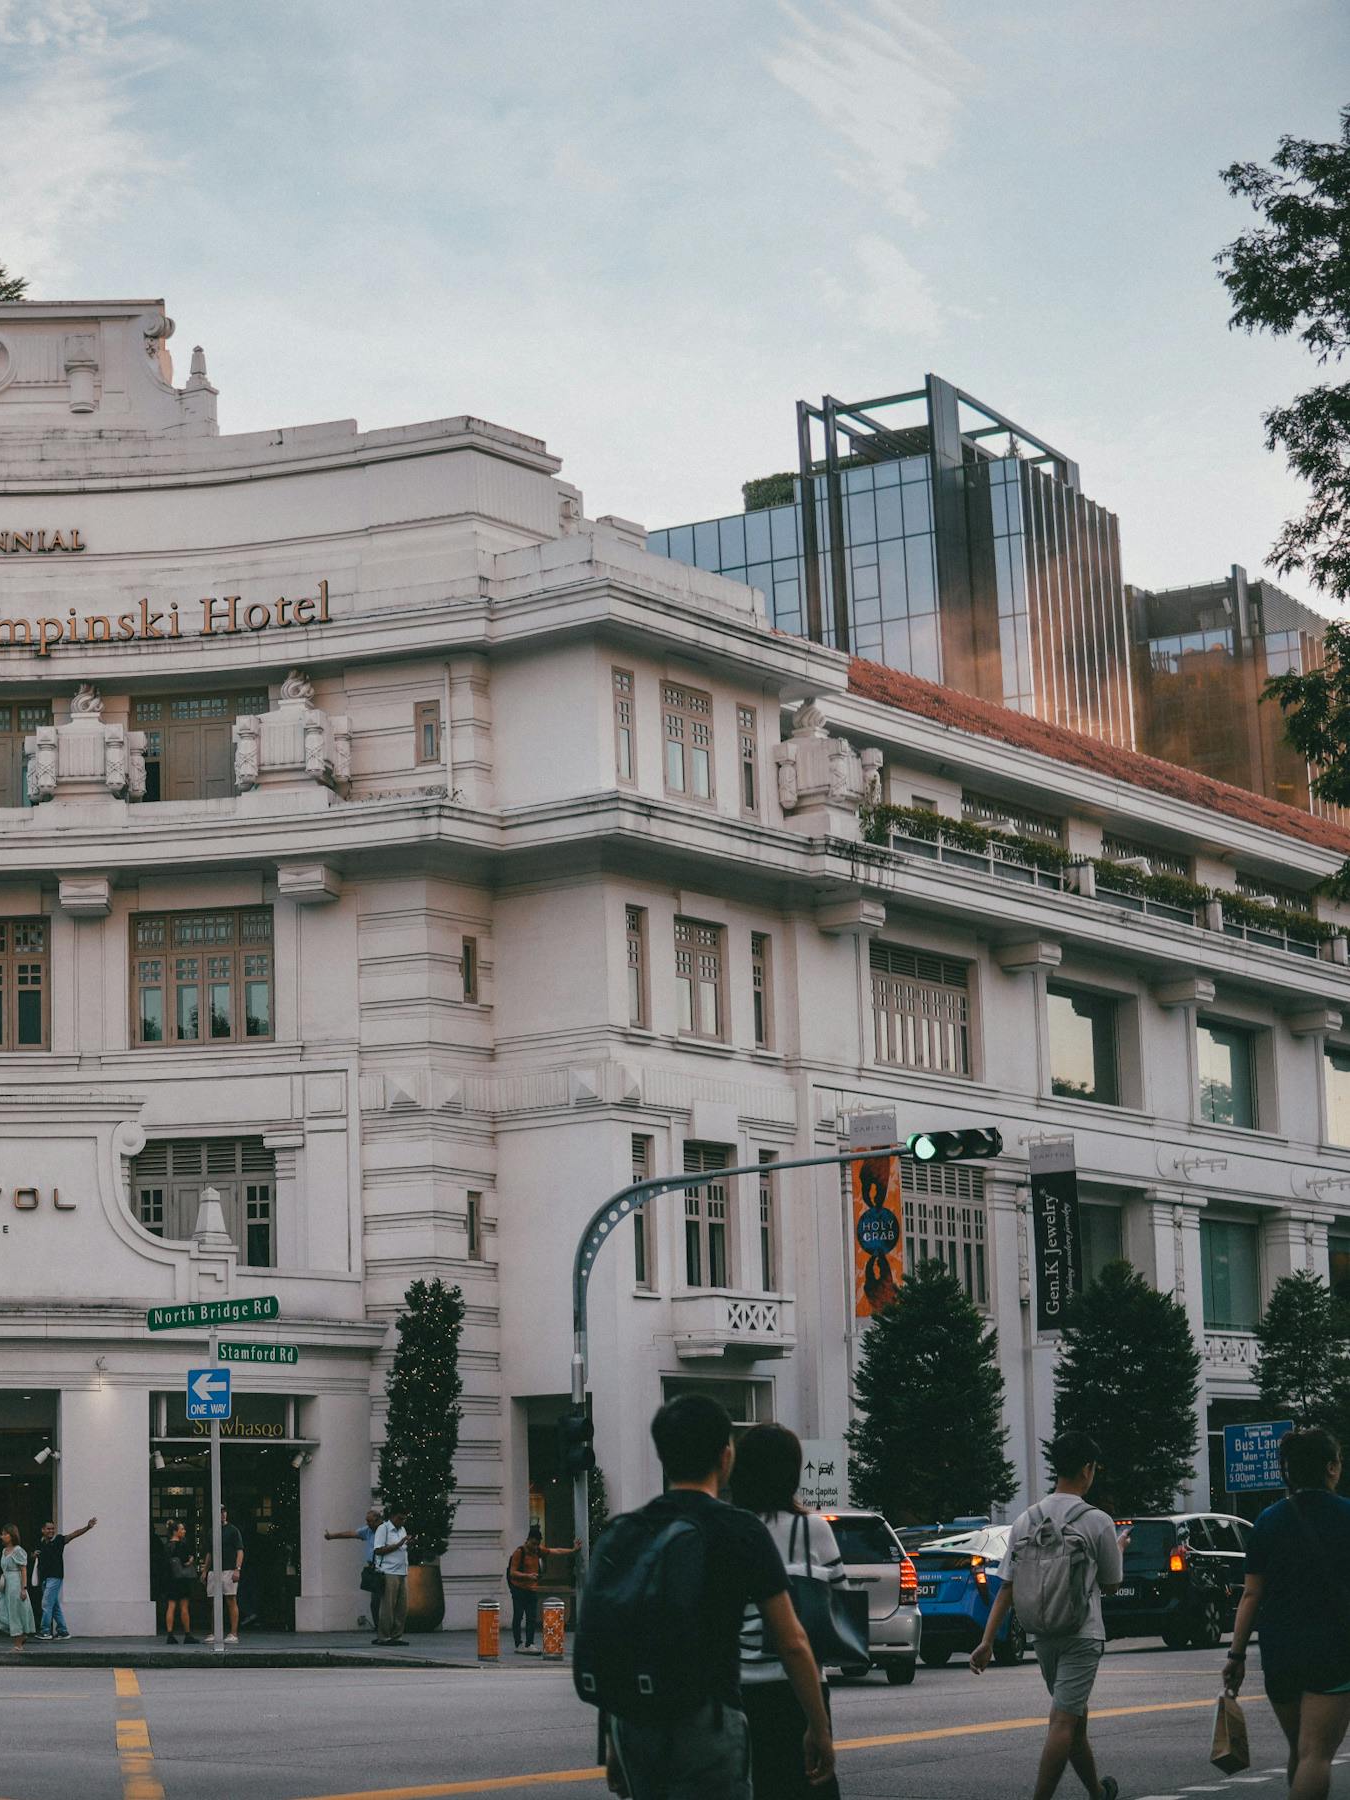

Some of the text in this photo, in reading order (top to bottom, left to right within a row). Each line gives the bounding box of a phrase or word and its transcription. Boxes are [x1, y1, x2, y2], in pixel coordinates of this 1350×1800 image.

[198, 579, 334, 636] Hotel
[862, 1220, 894, 1231] HOLY
[862, 1231, 895, 1242] CRAB
[1045, 1260, 1061, 1315] Gen.K
[154, 1299, 271, 1324] North Bridge Rd
[220, 1344, 294, 1362] Stamford Rd
[190, 1403, 227, 1415] ONE WAY
[193, 1416, 283, 1437] Suwhasoo
[1234, 1438, 1255, 1452] Bus
[1242, 1452, 1258, 1461] Mon
[1266, 1450, 1276, 1459] Fri
[1263, 1460, 1282, 1470] 9.30
[815, 1488, 838, 1497] Capitol
